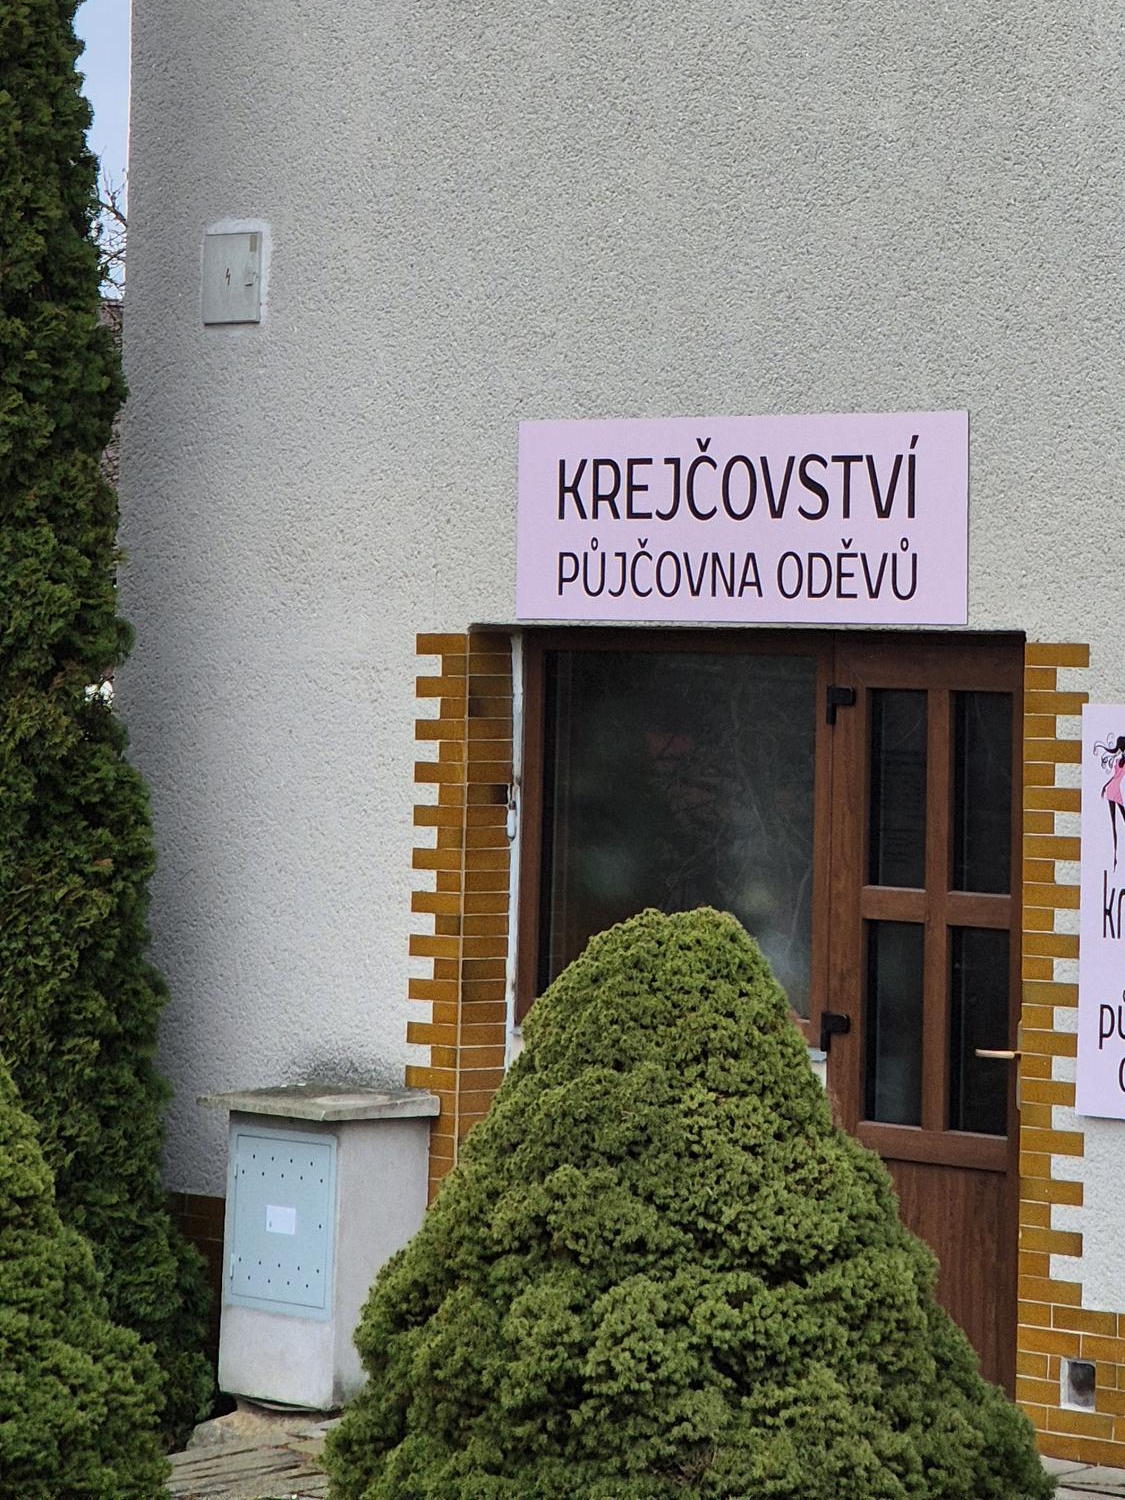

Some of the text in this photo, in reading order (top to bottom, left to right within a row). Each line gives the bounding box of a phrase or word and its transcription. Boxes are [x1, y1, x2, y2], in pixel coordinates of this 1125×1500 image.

[557, 434, 919, 521] KREJČOVSTVÍ
[557, 537, 918, 600] PŮJČOVNA ODĚVŮ
